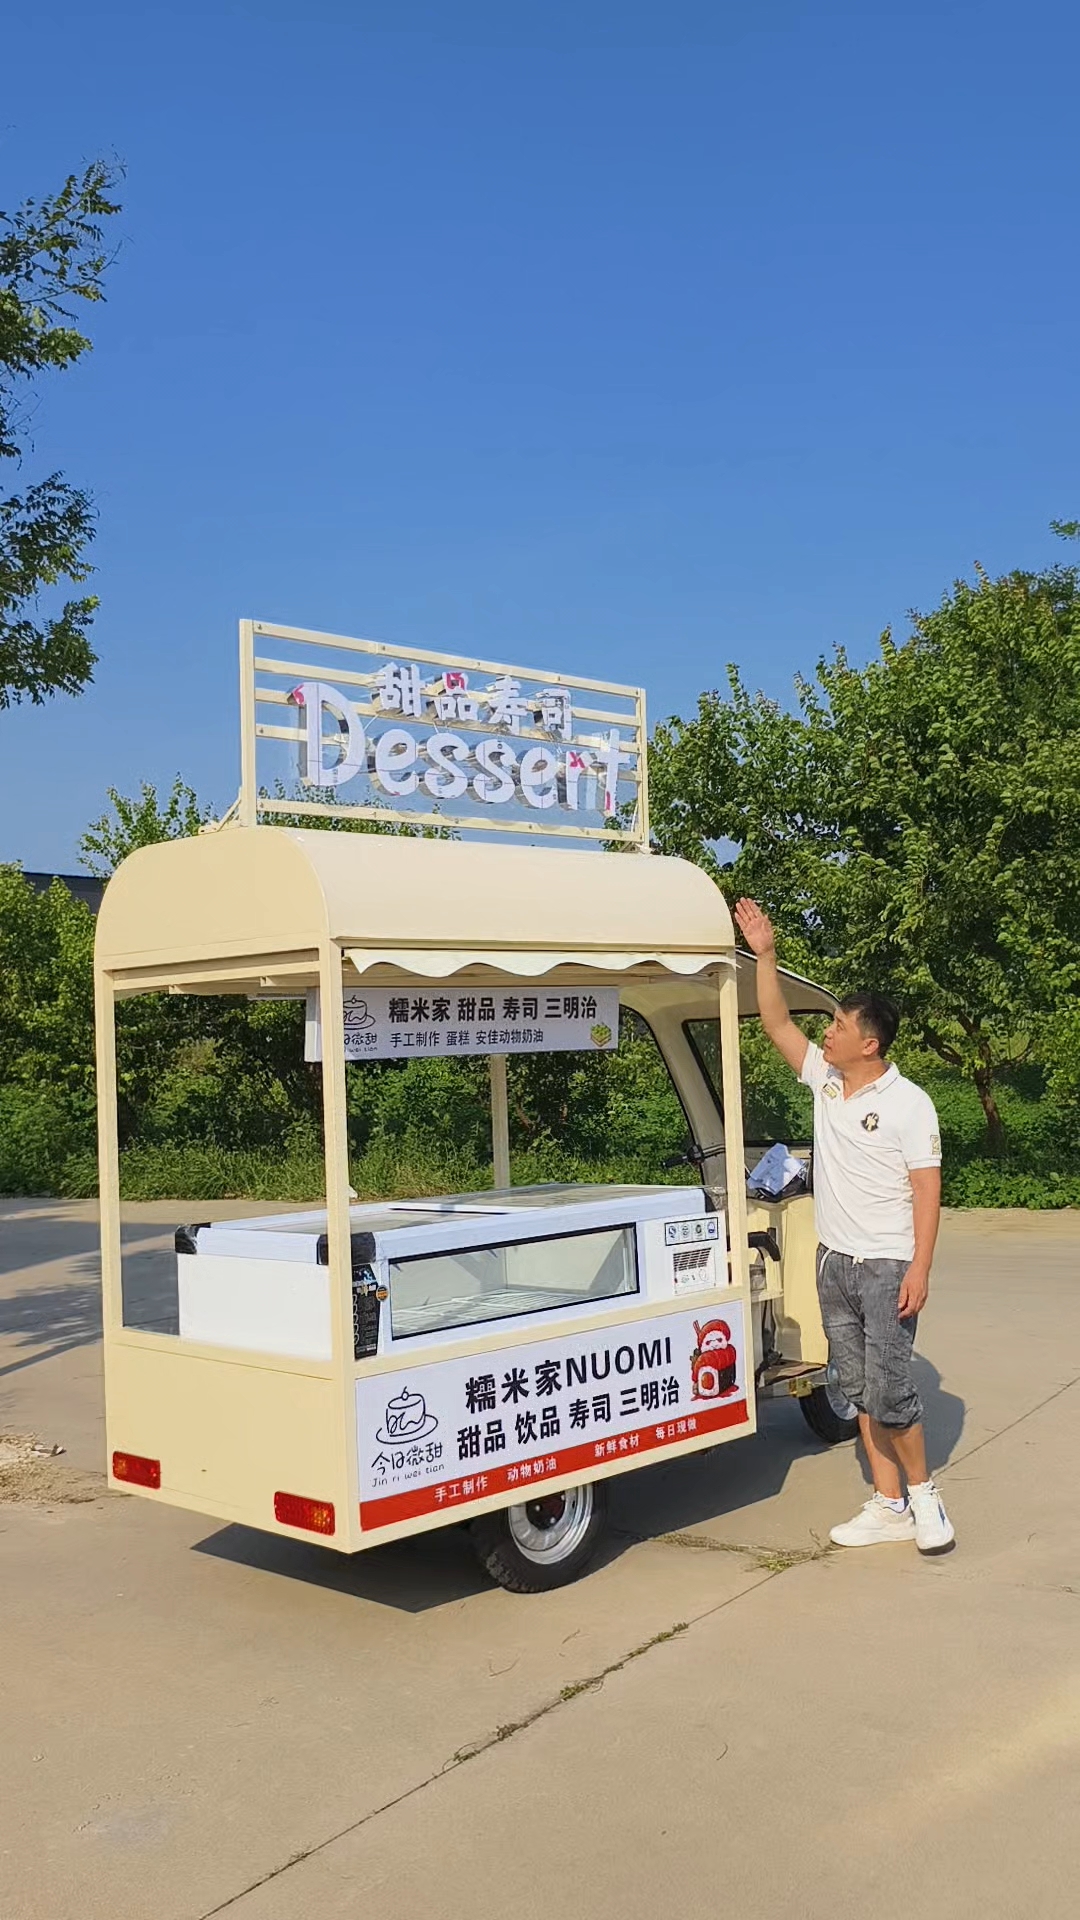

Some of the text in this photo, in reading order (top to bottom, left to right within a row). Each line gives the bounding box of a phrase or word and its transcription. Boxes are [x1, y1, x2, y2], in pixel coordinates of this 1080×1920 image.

[376, 661, 573, 740] 甜品寿司
[293, 681, 631, 816] Dessert
[388, 995, 598, 1023] 糯米家 甜品 寿司 三明治
[389, 1028, 544, 1049] 手工制作 蛋糕 安佳动物奶油
[457, 1376, 680, 1461] 甜品 饮品 寿司 三明治
[371, 1442, 443, 1475] 今日微甜
[404, 1470, 421, 1480] wei
[425, 1463, 445, 1474] tian
[434, 1416, 697, 1504] 手工制作 动物奶油 新鲜食材 每日现做
